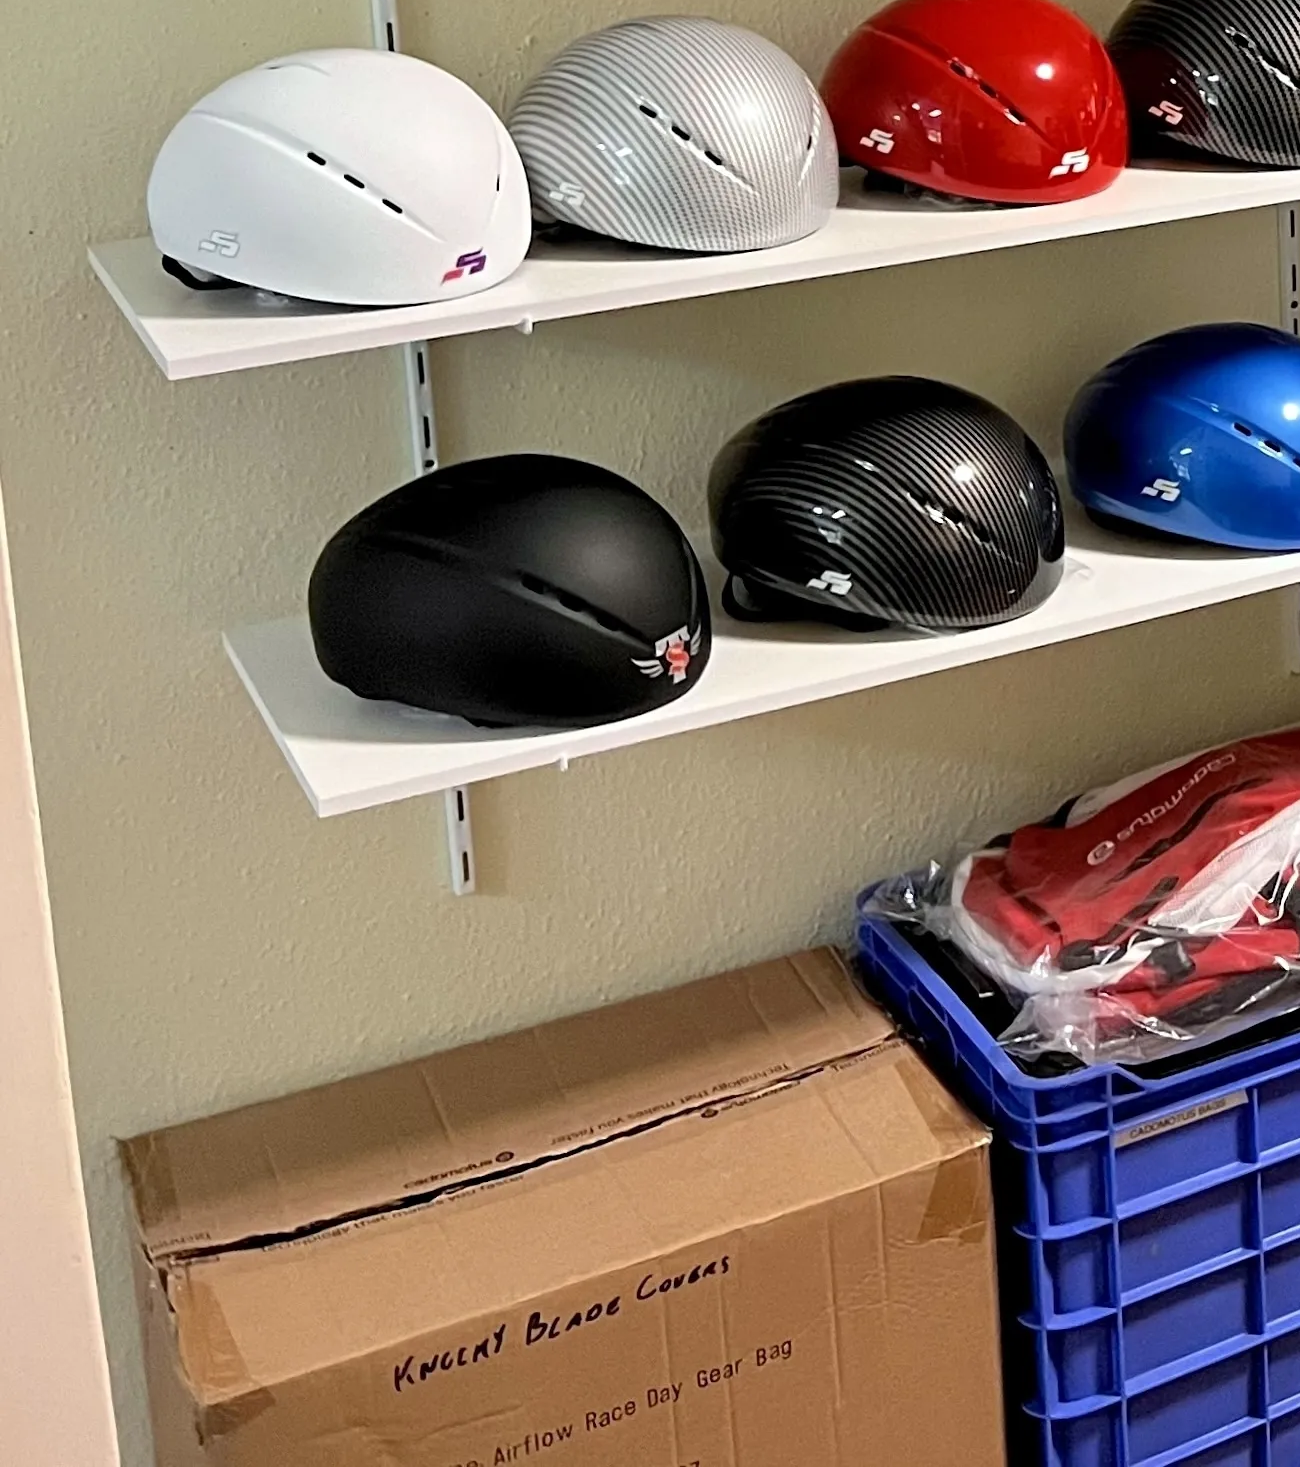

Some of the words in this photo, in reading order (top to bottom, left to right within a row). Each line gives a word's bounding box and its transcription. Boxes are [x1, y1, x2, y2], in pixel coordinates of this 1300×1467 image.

[493, 1422, 574, 1467] Airflow
[585, 1400, 637, 1432] Race
[647, 1380, 684, 1410] Day
[696, 1358, 744, 1390] Gear
[755, 1338, 794, 1368] Bag
